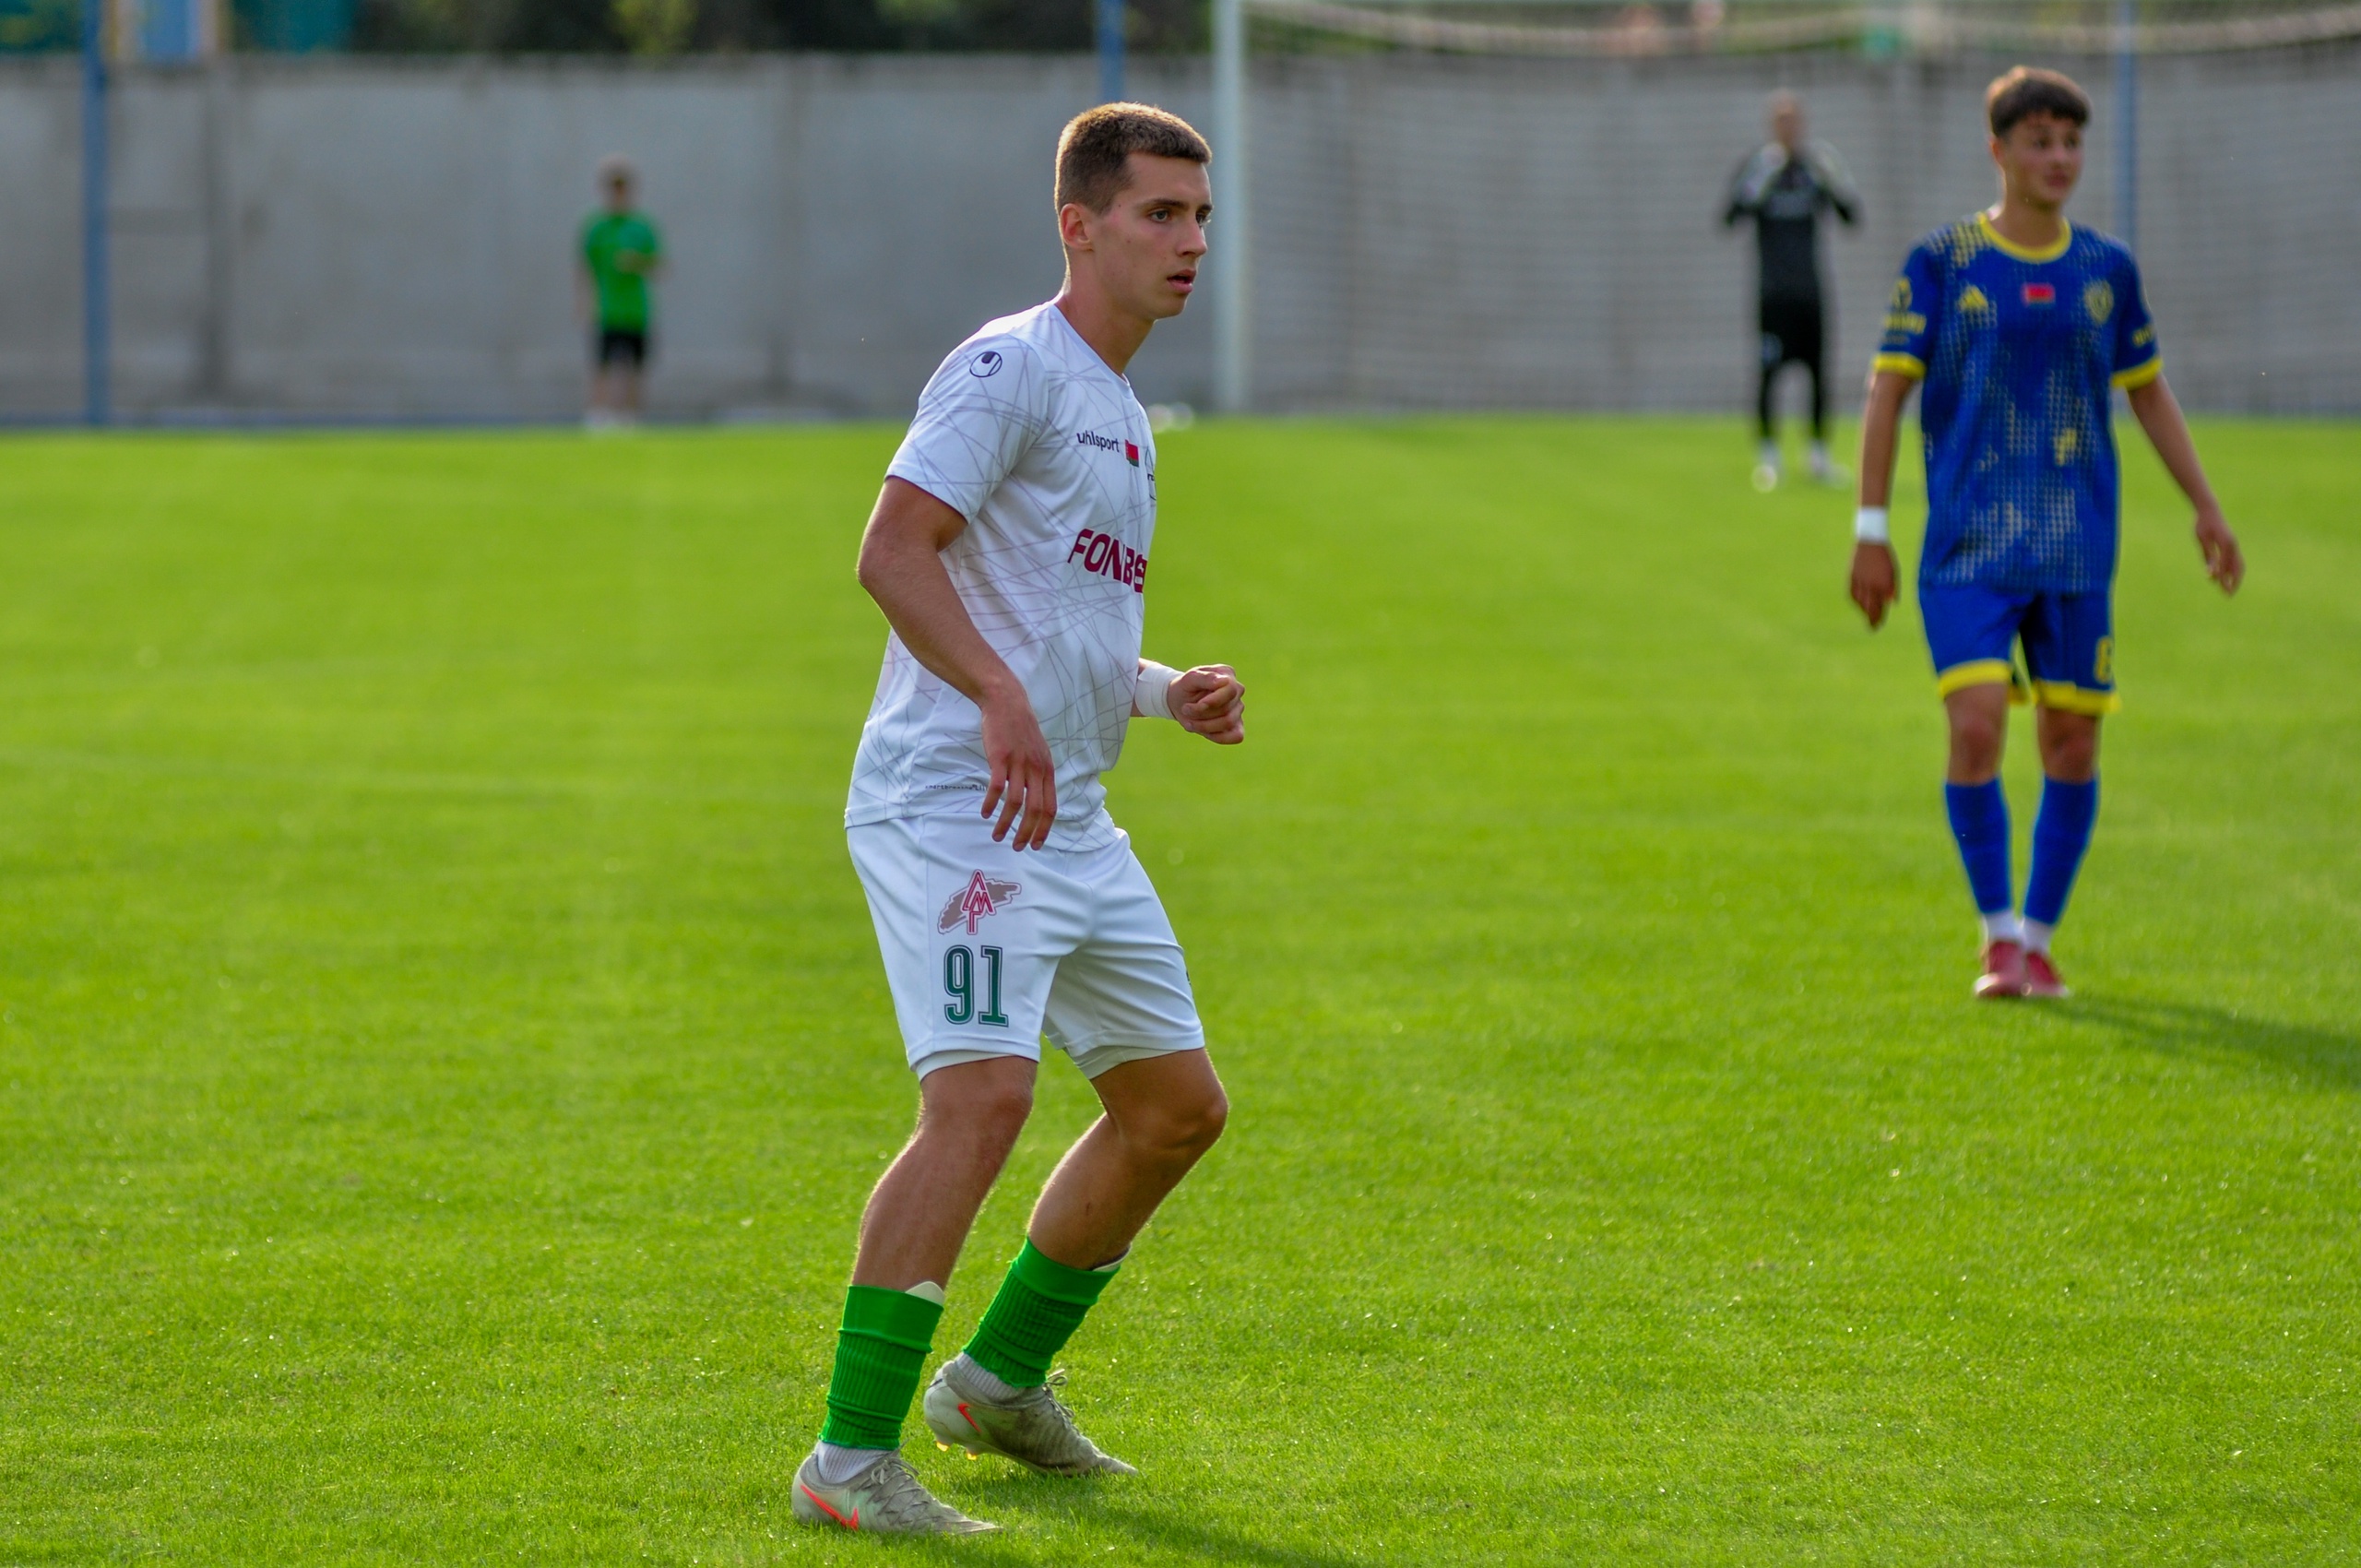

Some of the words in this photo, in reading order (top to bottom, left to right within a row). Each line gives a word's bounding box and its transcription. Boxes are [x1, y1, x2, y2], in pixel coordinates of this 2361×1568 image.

[1076, 430, 1120, 453] uhlsport
[1067, 528, 1148, 593] FONBE
[943, 944, 1009, 1028] 91
